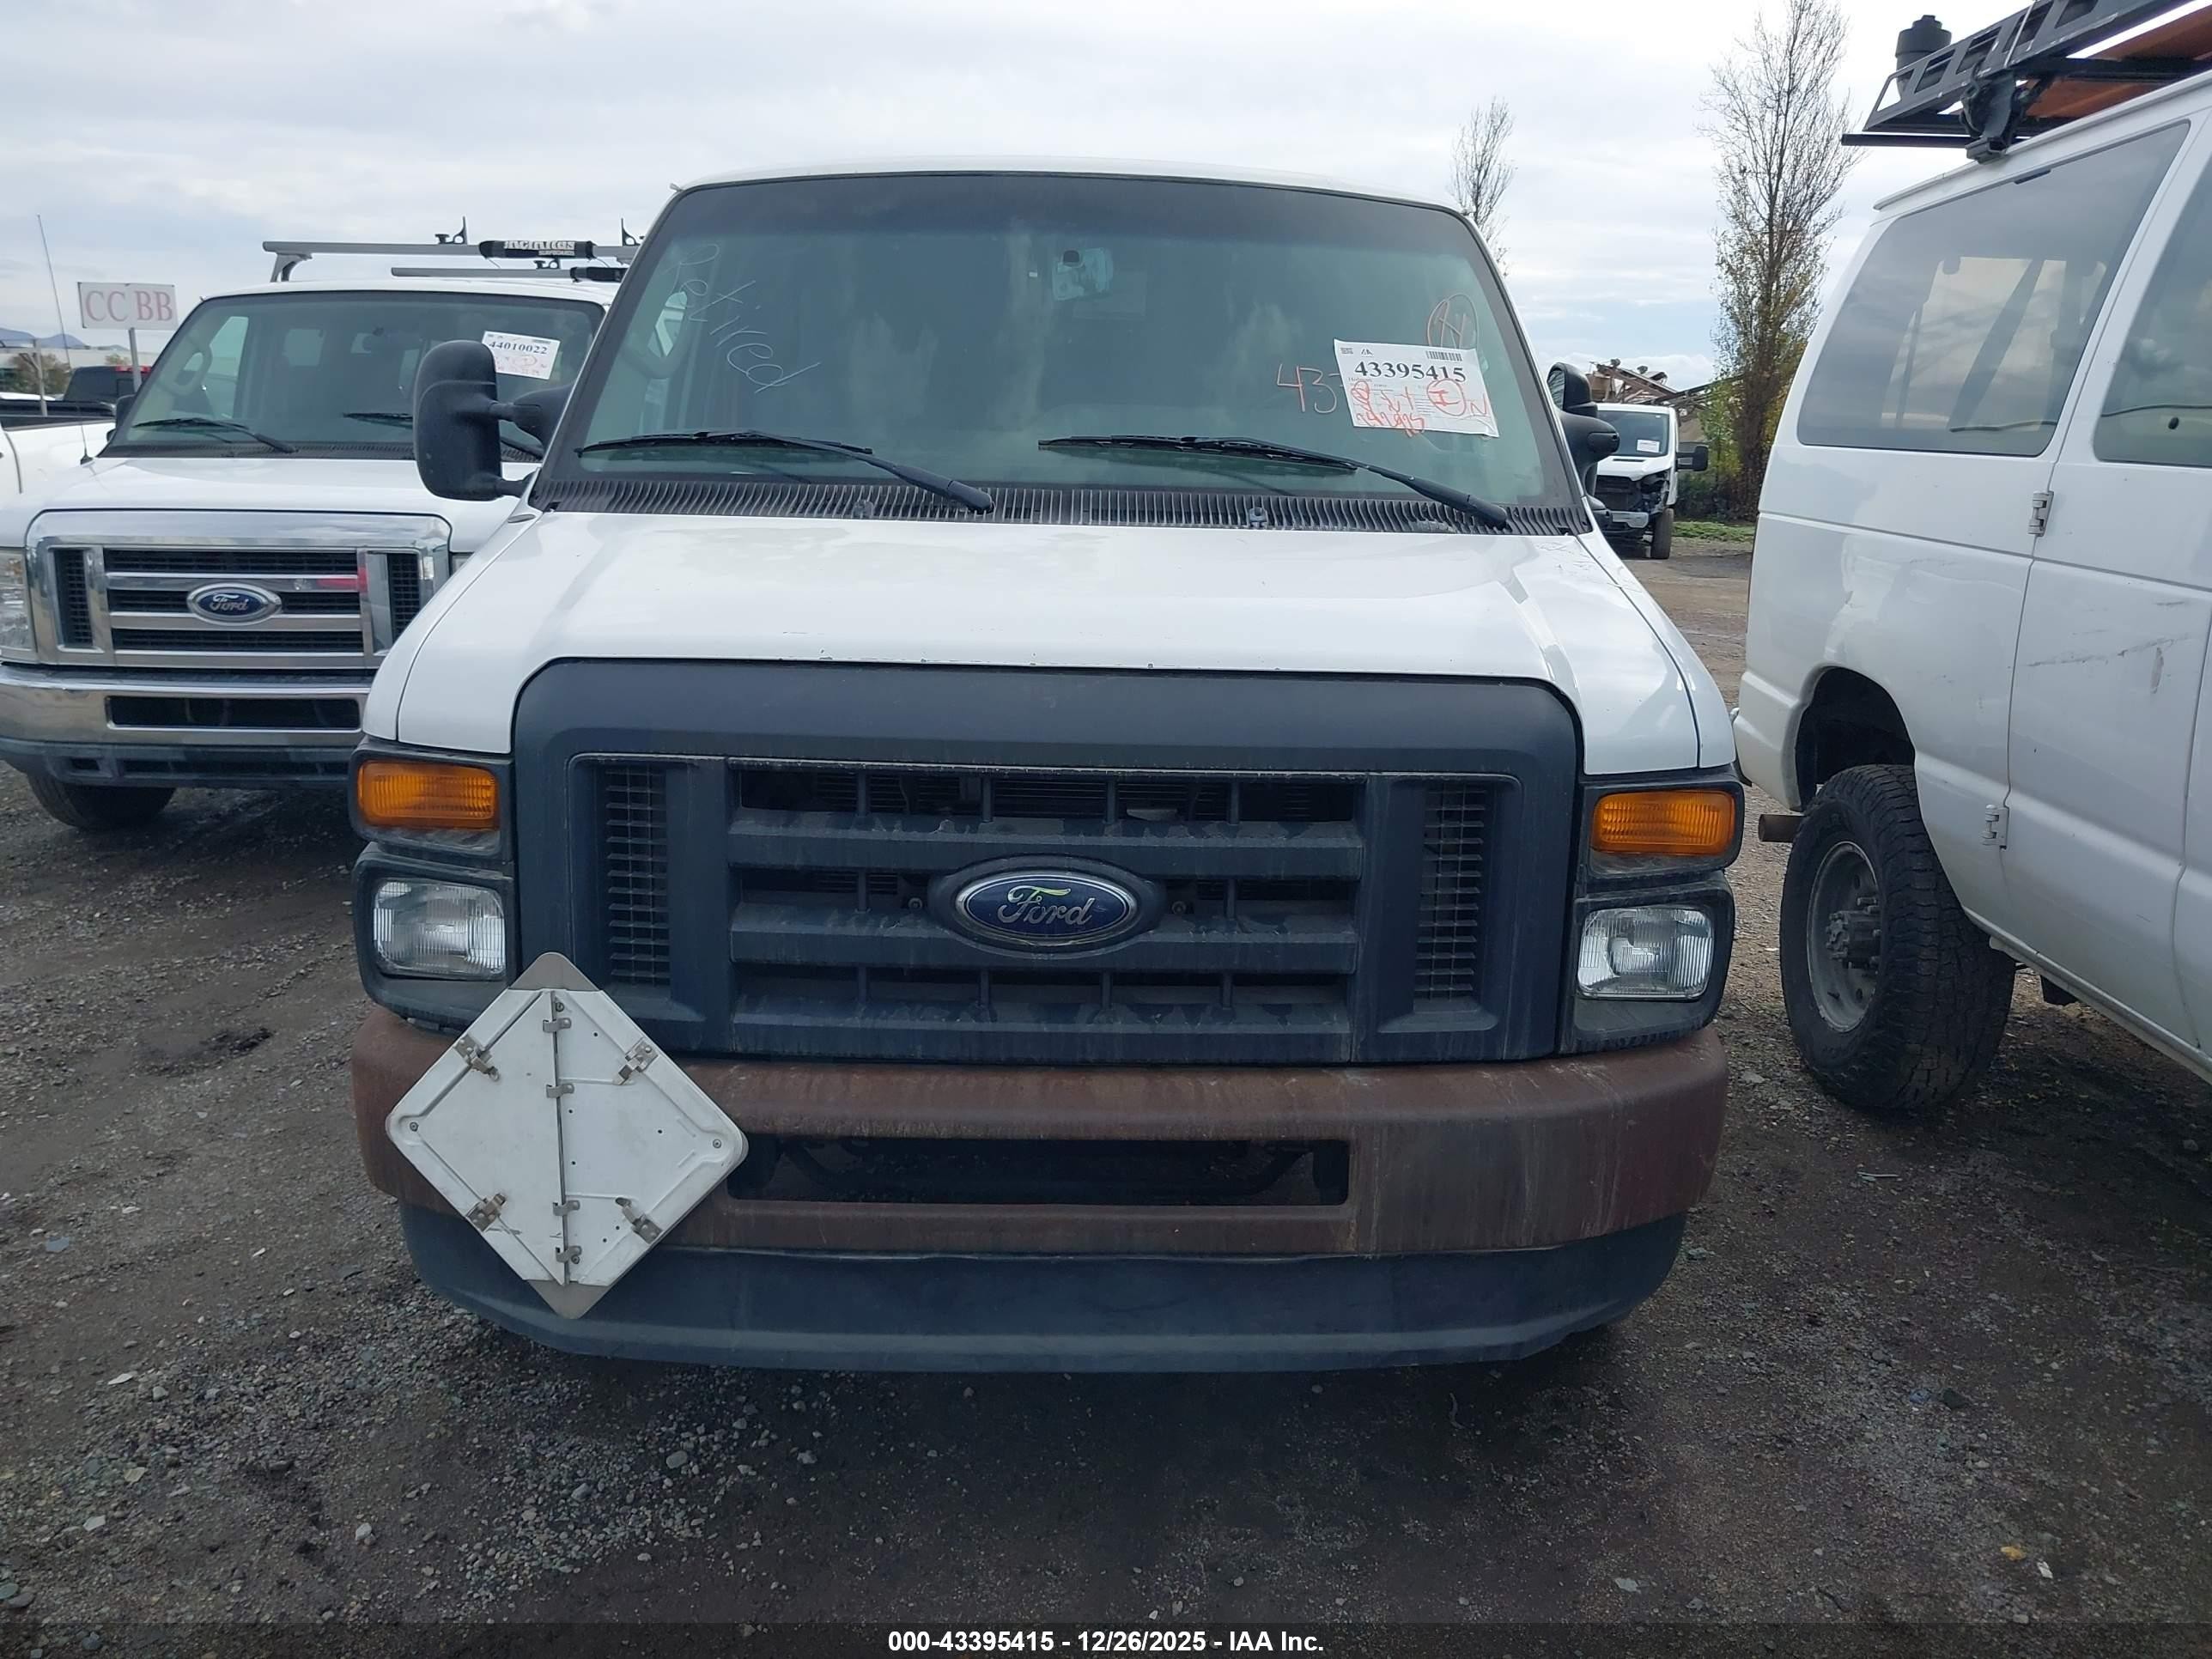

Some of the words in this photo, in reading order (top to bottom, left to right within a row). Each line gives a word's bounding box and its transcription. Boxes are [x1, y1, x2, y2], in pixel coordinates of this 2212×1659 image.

[488, 341, 548, 355] 44010022
[1354, 361, 1467, 383] 43395415
[209, 593, 249, 611] Ford
[996, 884, 1096, 926] Ford
